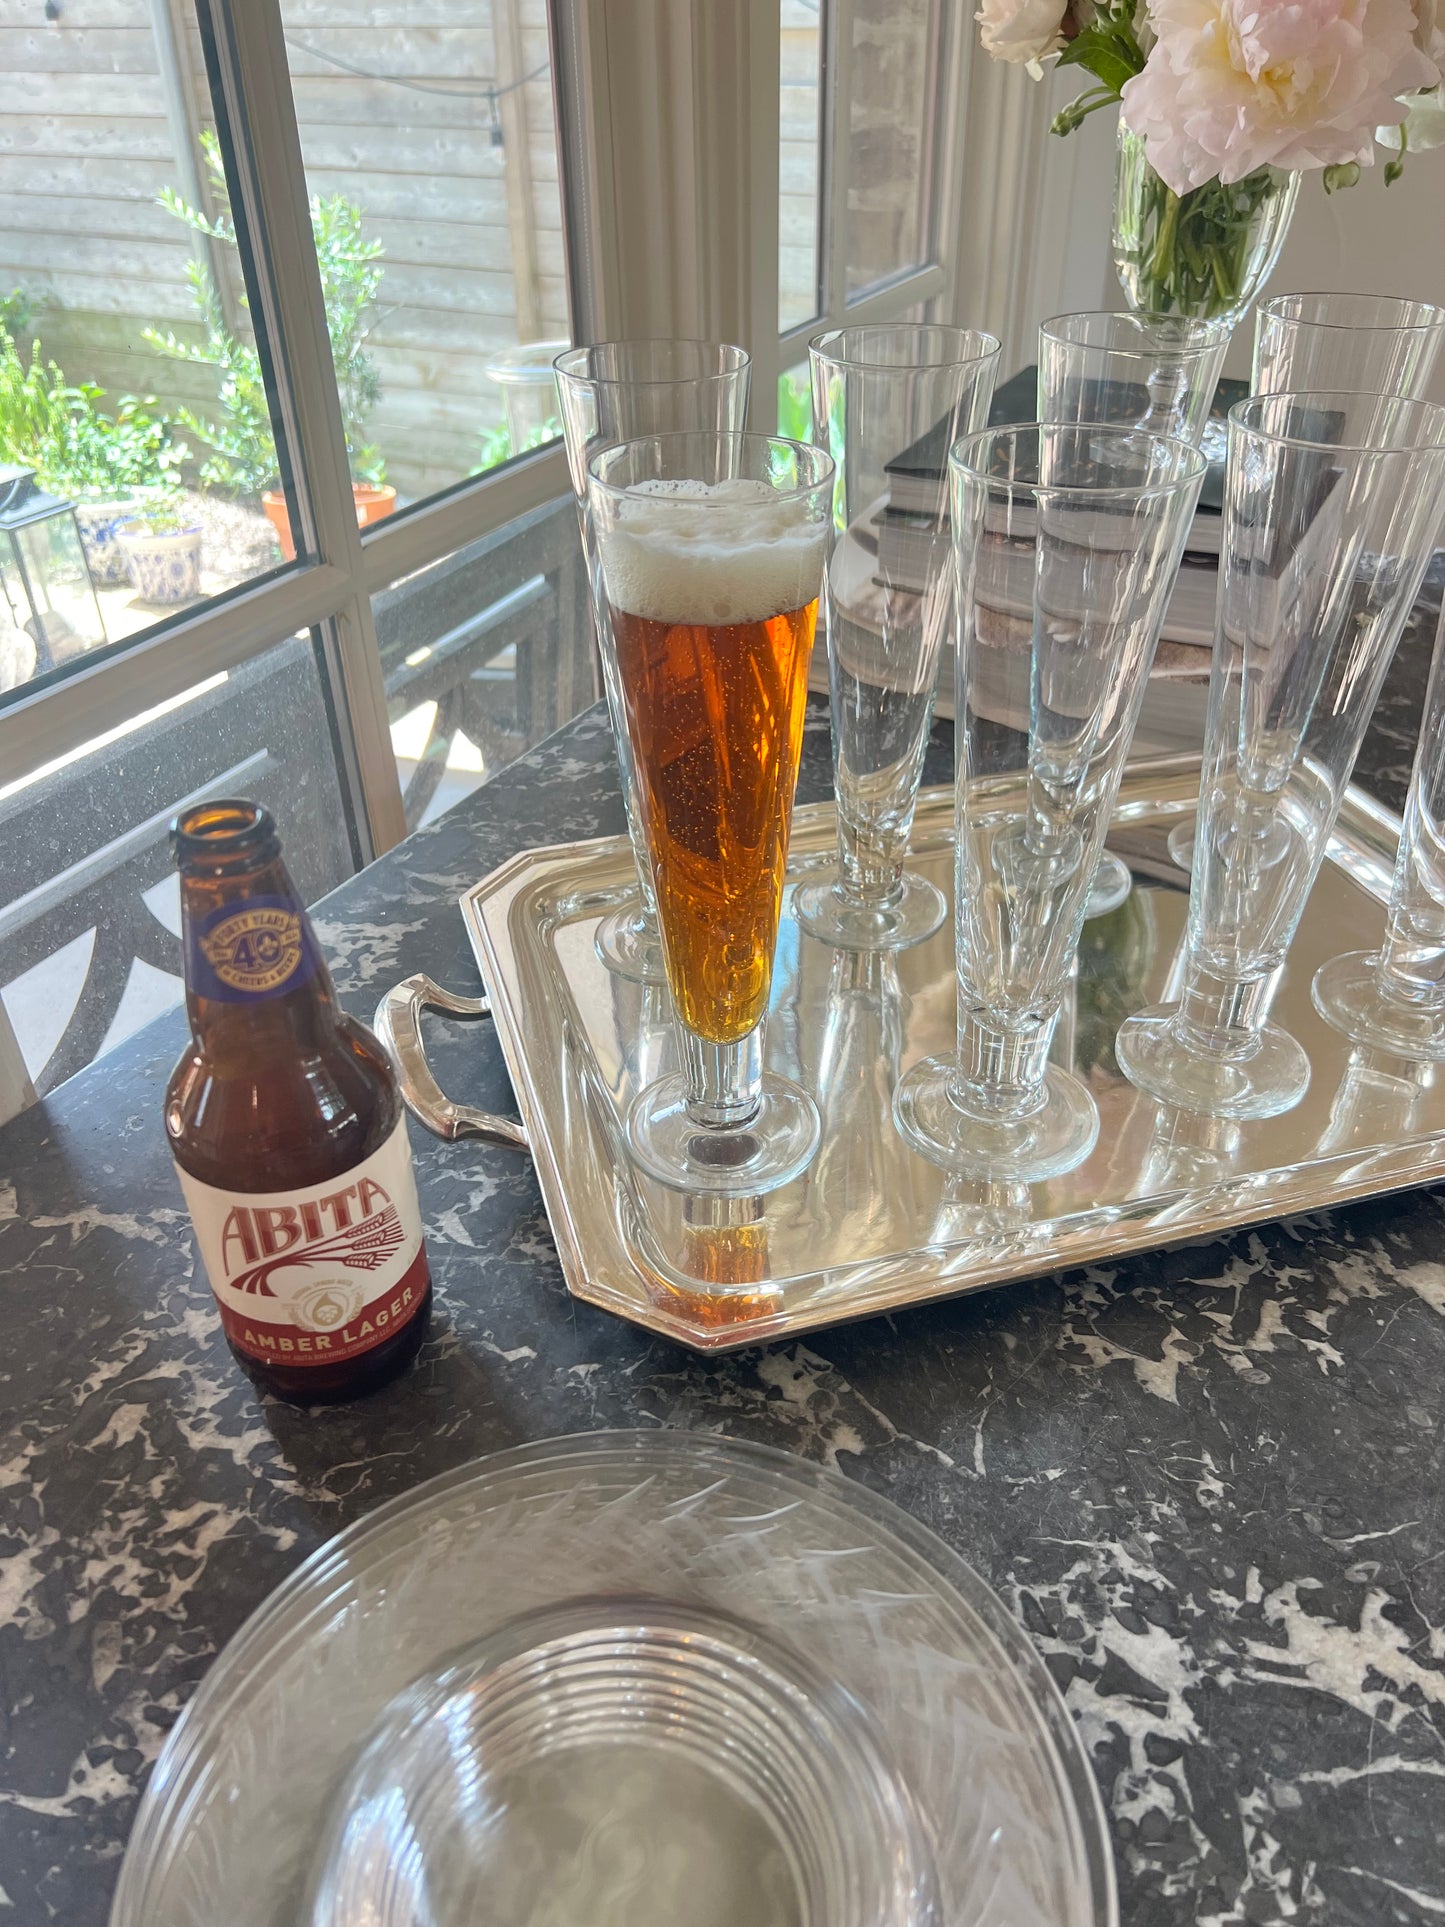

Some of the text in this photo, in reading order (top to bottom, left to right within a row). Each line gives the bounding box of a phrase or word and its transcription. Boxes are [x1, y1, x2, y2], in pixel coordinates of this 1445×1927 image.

[215, 912, 285, 943] FORTY YEARS
[233, 931, 281, 969] 40
[222, 1176, 392, 1277] ABITA
[244, 1329, 332, 1352] AMBER
[343, 1286, 413, 1344] LAGER
[314, 1348, 347, 1361] BREWING
[347, 1332, 379, 1353] COMPANY
